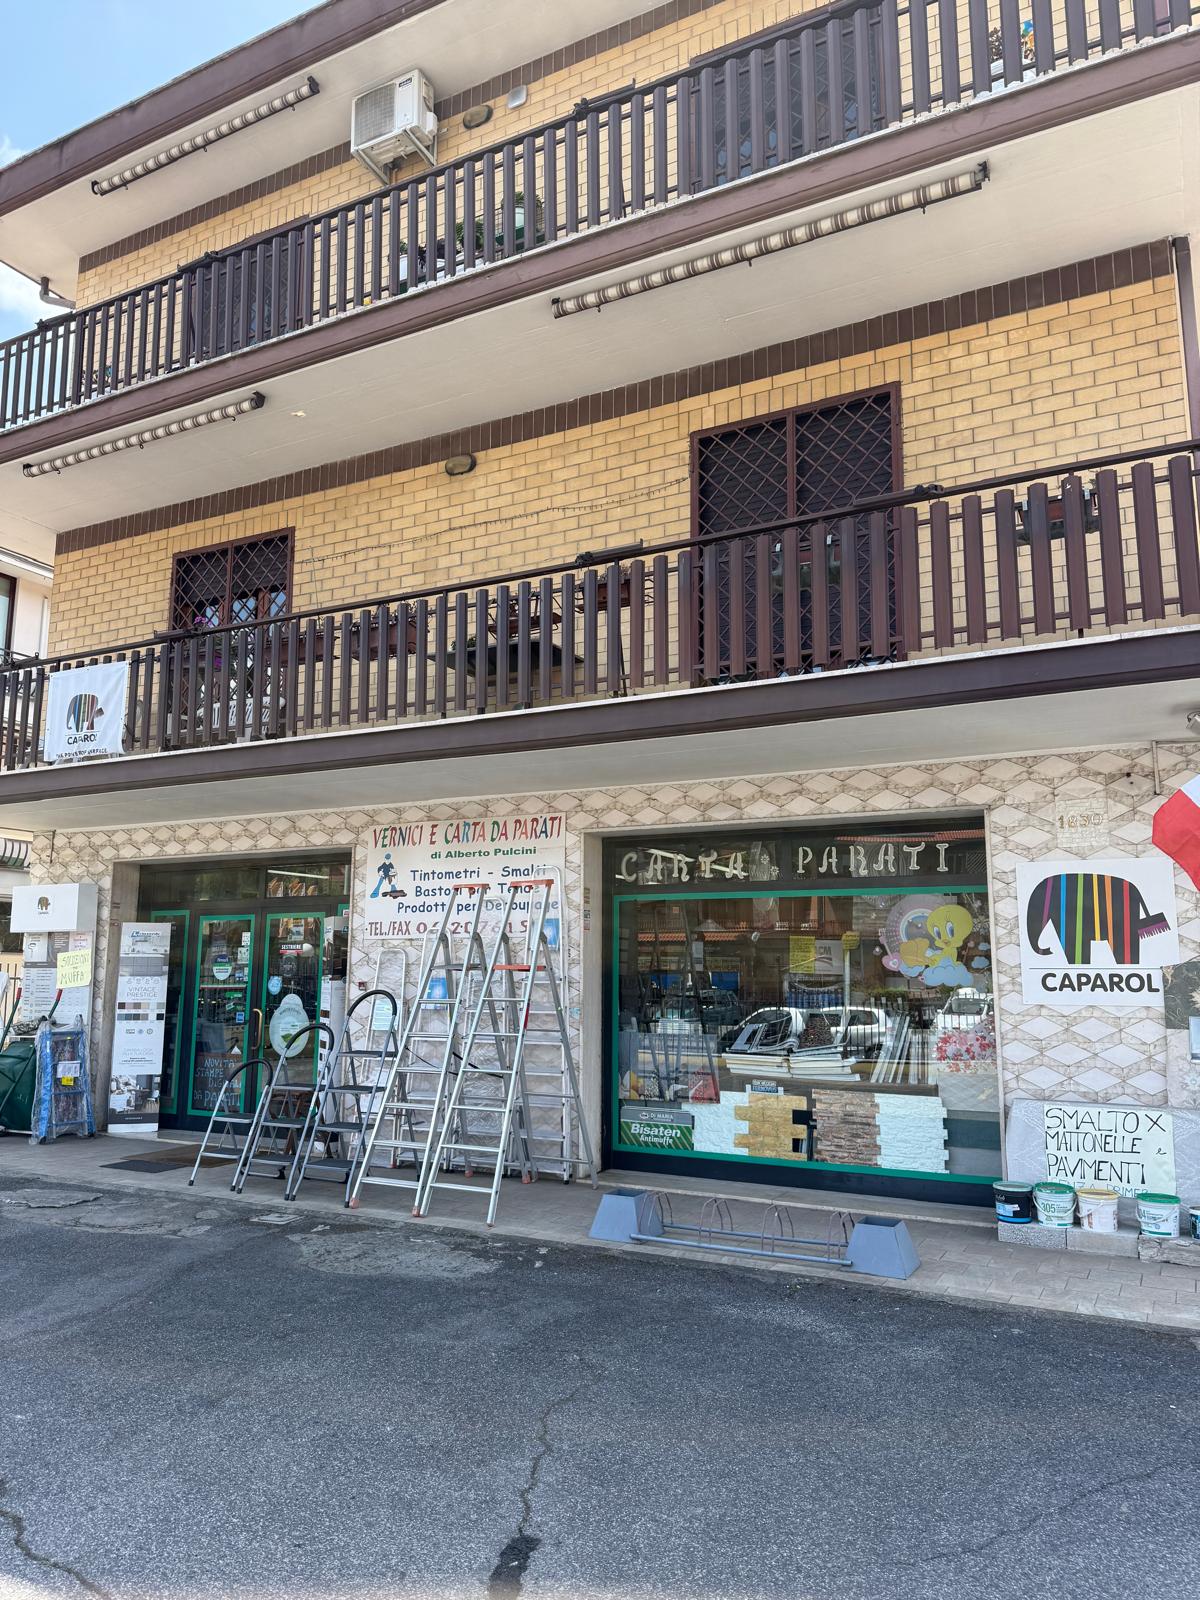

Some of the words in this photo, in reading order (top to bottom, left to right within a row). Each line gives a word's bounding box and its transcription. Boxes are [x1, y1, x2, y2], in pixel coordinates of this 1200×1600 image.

[373, 824, 424, 849] VERNICI
[429, 823, 439, 846] E
[444, 820, 486, 845] CARTA
[490, 820, 508, 842] DA
[513, 816, 562, 841] PARATI
[431, 850, 441, 859] di
[445, 849, 490, 859] Alberto
[494, 846, 537, 856] Pulcini
[620, 849, 747, 883] CARTA
[798, 841, 949, 876] PARATI
[410, 867, 480, 881] Tintometri
[397, 902, 449, 913] Prodott
[456, 903, 477, 915] per
[368, 921, 411, 937] TEL./FAX
[1041, 973, 1160, 993] CAPAROL
[1045, 1107, 1139, 1134] SMALTO
[631, 1123, 681, 1138] Bisaten
[640, 1134, 674, 1146] Antimuffe
[1045, 1130, 1143, 1154] MATTONELLE
